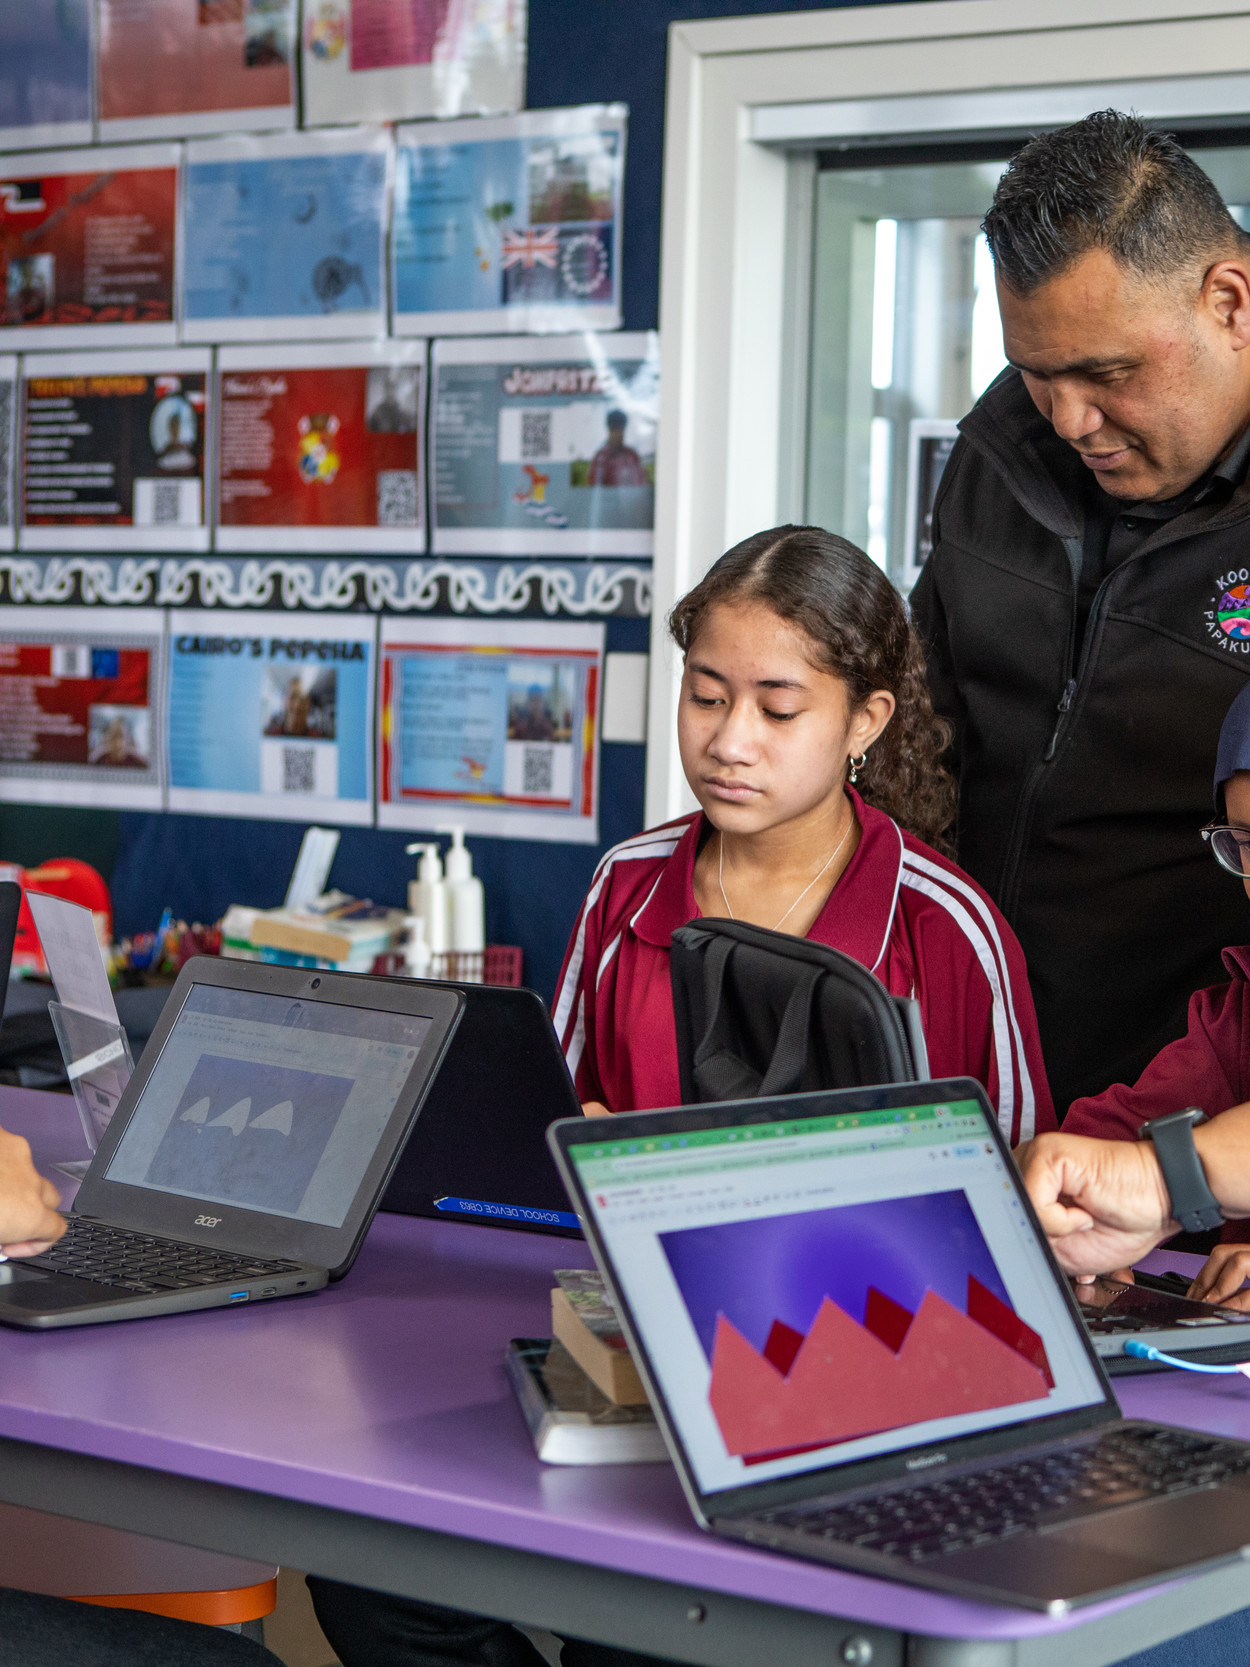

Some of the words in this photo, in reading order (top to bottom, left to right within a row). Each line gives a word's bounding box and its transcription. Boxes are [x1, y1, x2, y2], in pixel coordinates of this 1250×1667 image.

[484, 1204, 519, 1217] DEVICE
[520, 1209, 560, 1223] SCHOOL
[194, 1215, 222, 1228] acer
